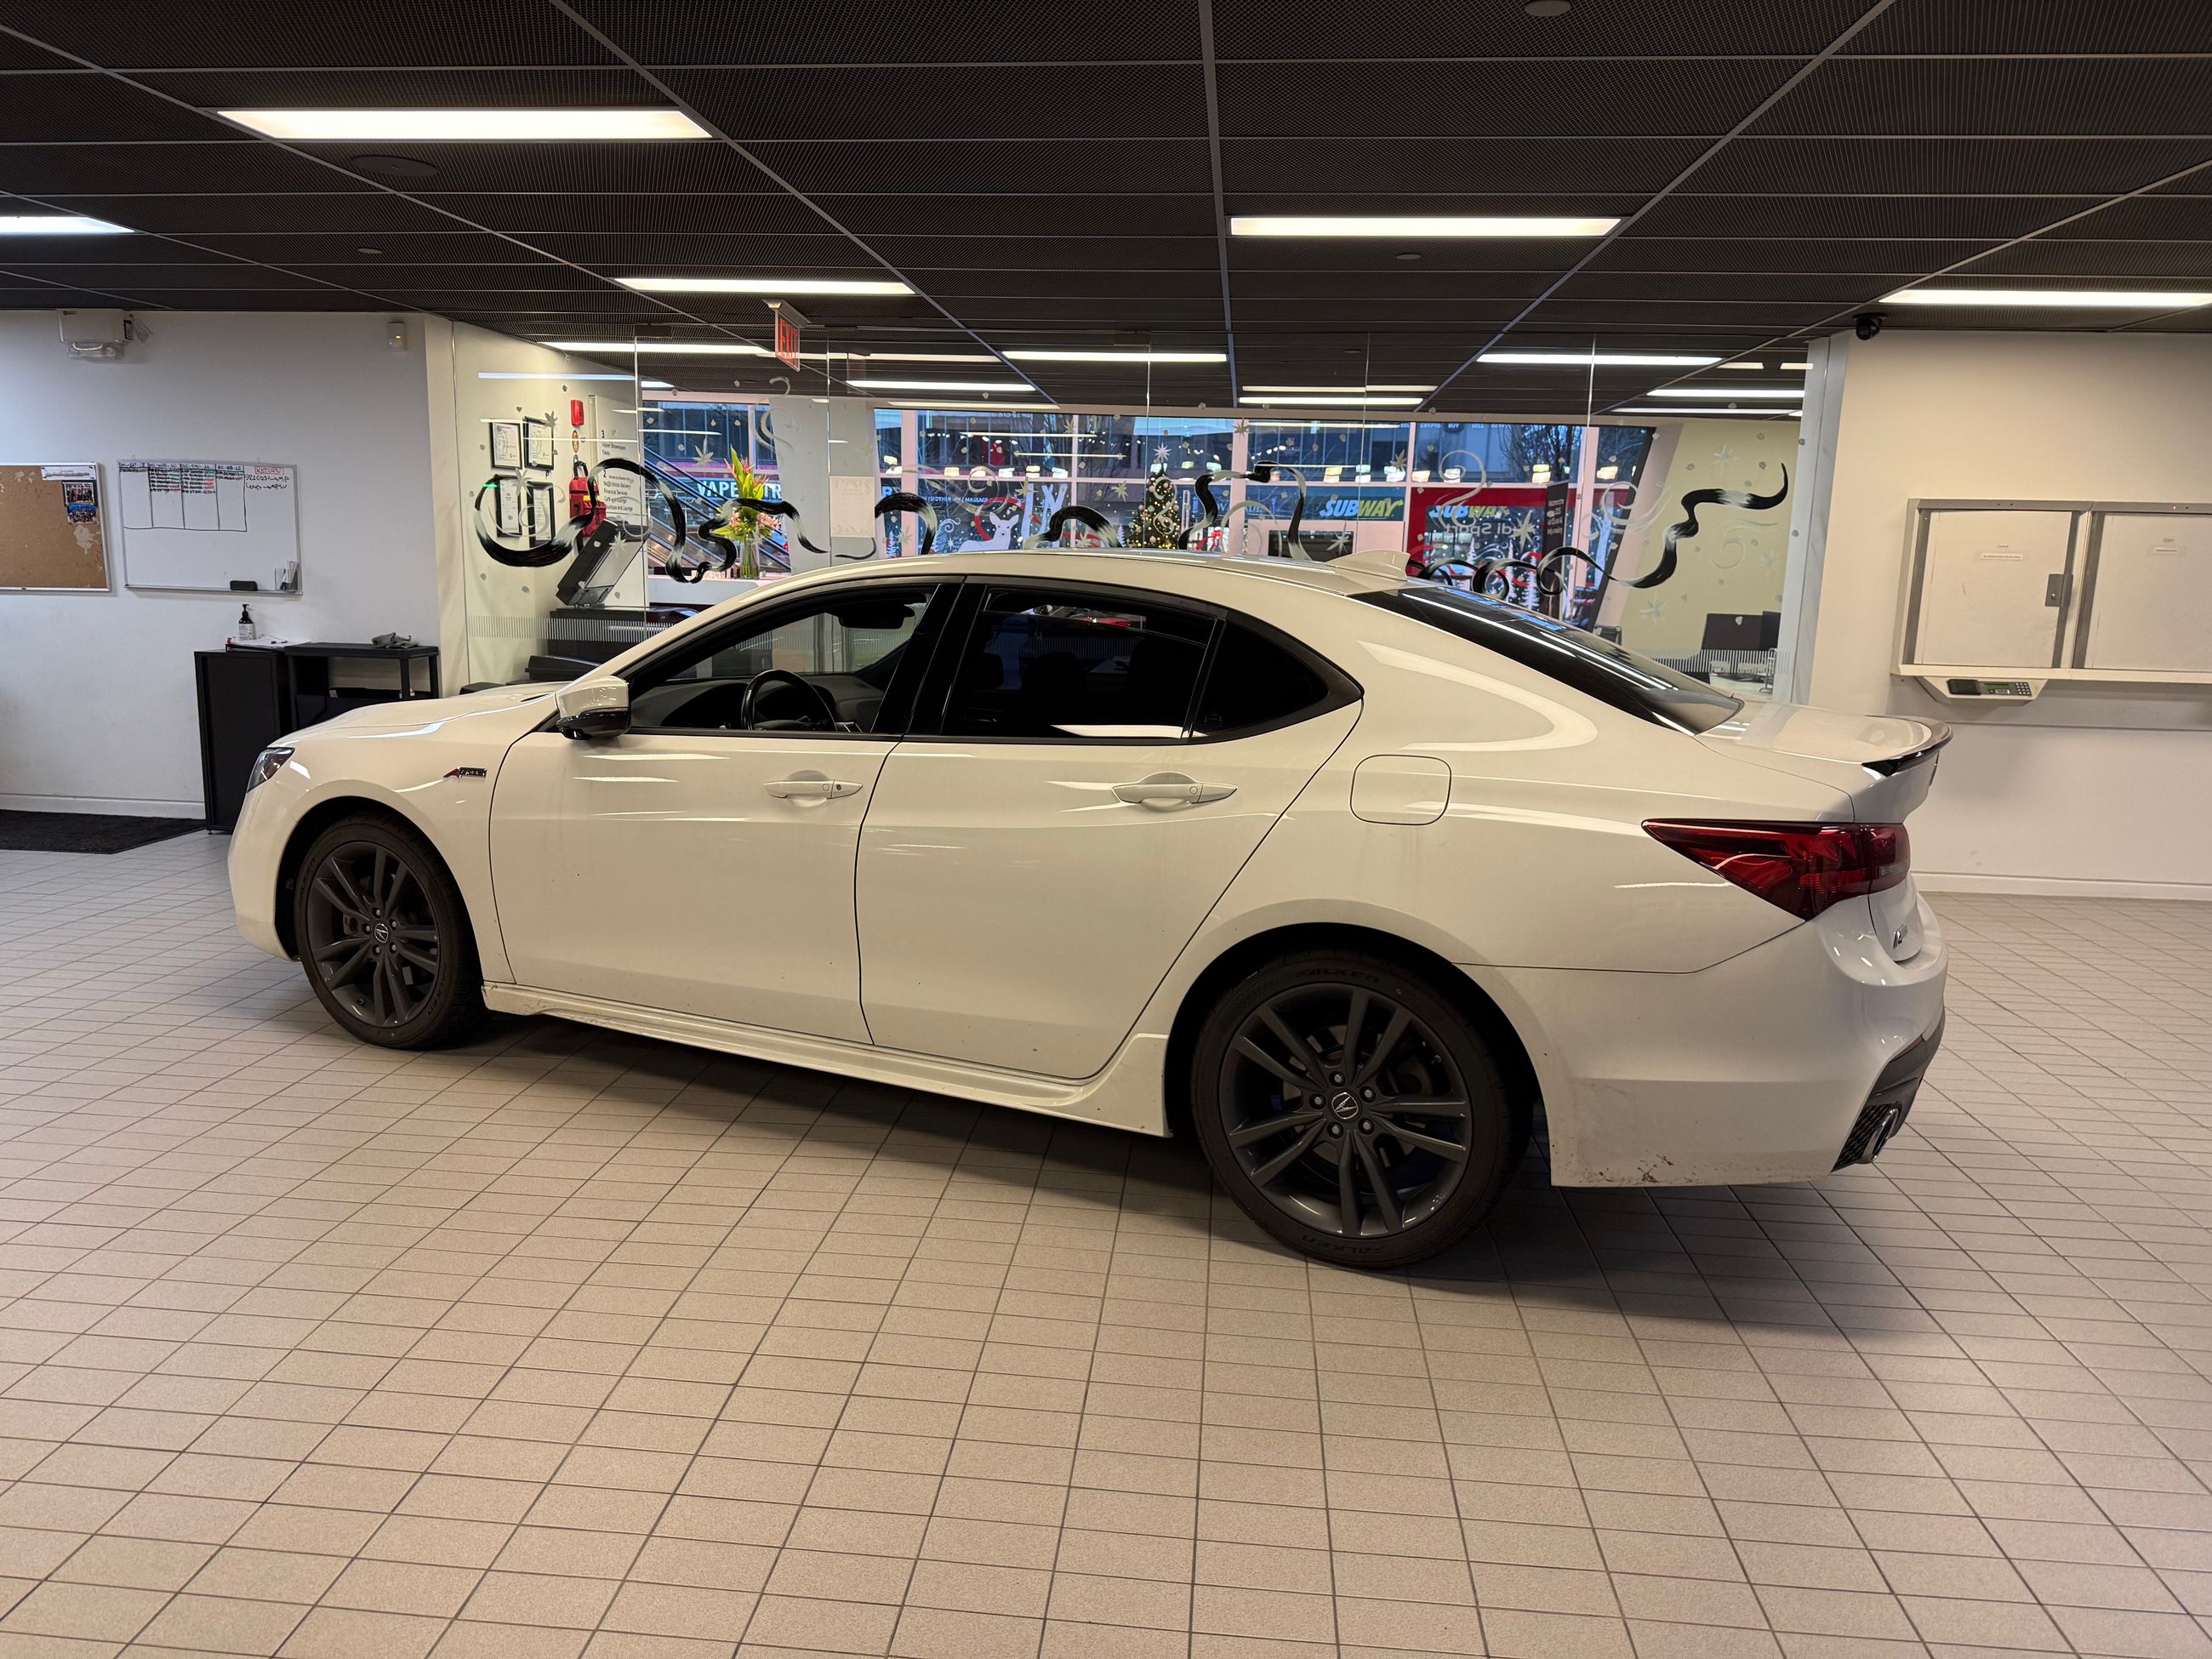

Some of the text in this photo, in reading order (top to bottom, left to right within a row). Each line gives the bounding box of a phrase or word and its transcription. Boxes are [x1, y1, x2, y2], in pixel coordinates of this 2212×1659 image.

[779, 318, 798, 367] EXIT
[601, 430, 605, 439] 3
[603, 470, 607, 478] 2
[697, 481, 740, 498] VAPE
[1320, 499, 1404, 517] SUBWAY
[1296, 968, 1380, 983] FALKEN
